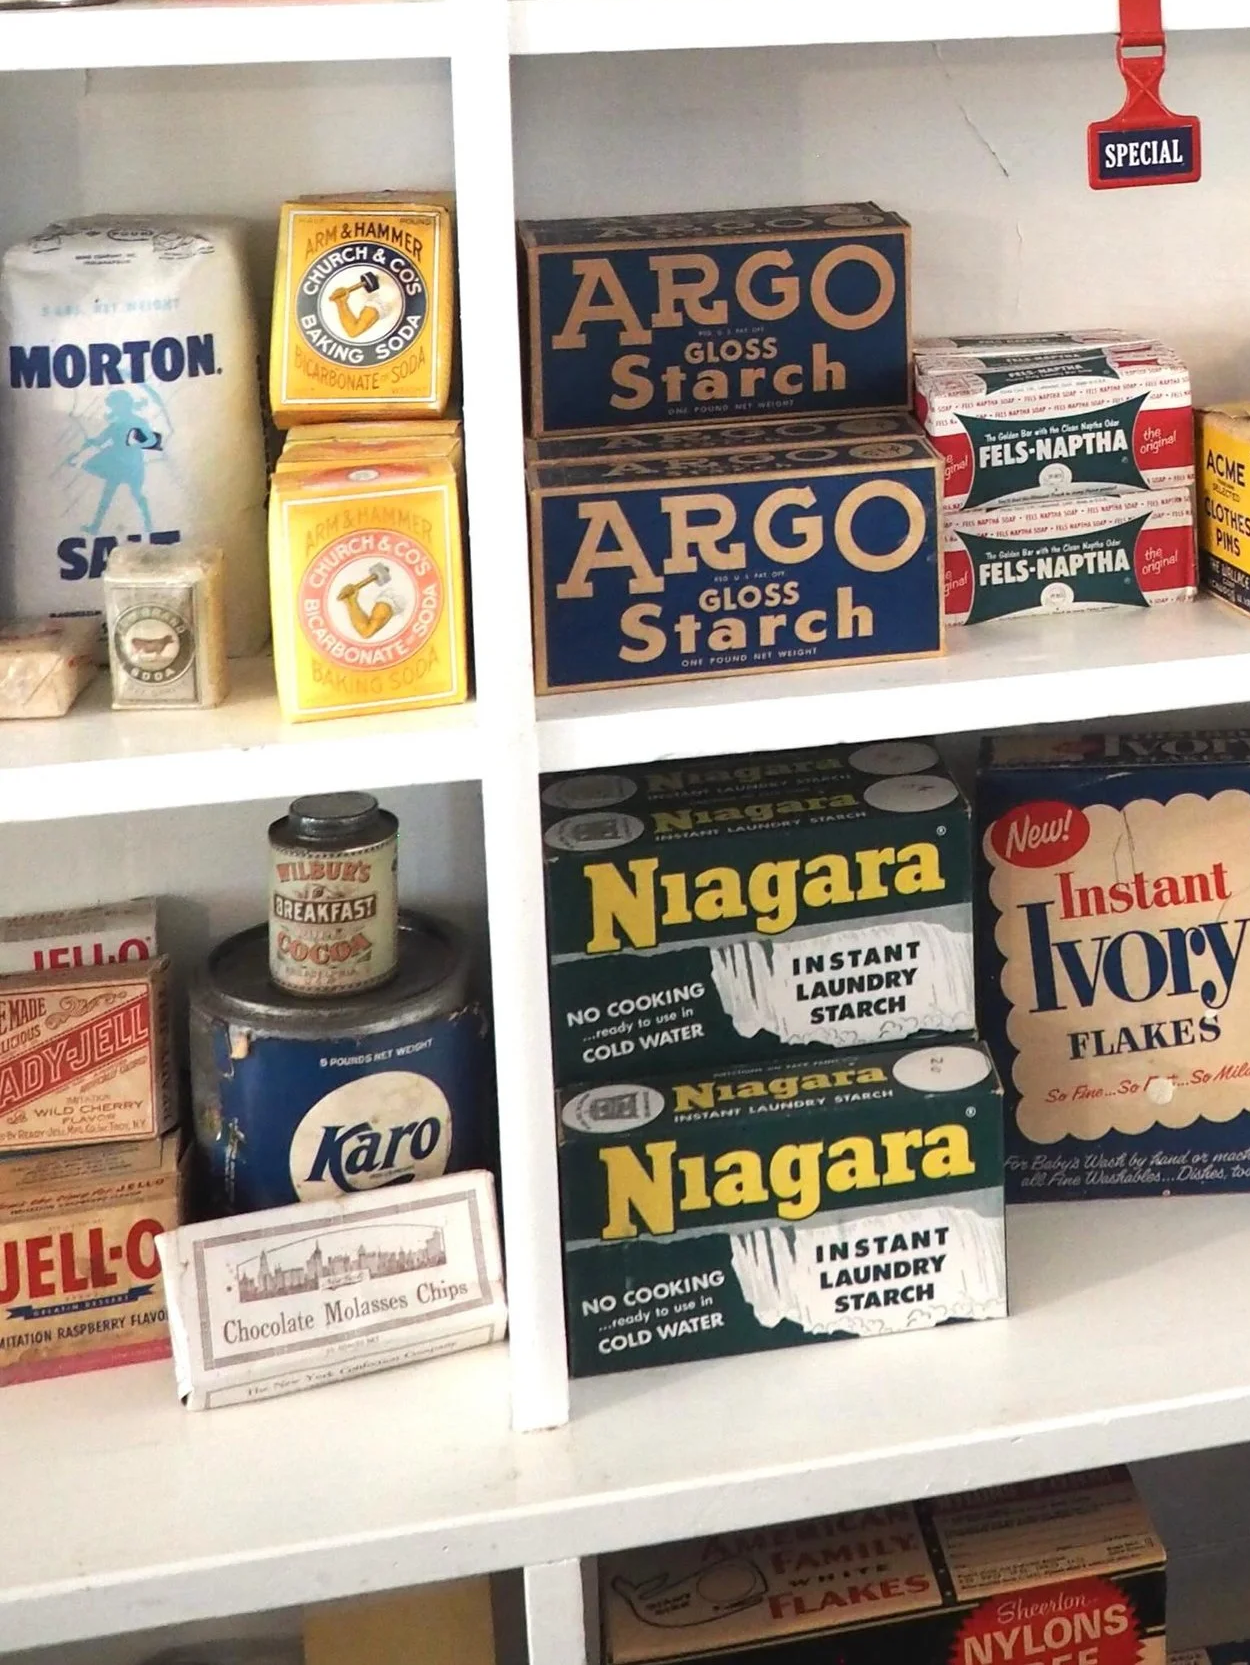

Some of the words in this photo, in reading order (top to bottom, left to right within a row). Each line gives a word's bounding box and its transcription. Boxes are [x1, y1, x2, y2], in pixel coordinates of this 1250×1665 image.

[1105, 139, 1183, 168] SPECIAL
[301, 315, 364, 363] BAKING
[375, 315, 421, 360] SODA
[979, 429, 1128, 469] FELS-NAPTHA
[556, 479, 926, 599] ARGO
[699, 582, 799, 612] GLOSS
[618, 587, 874, 663] Starch
[1005, 810, 1072, 860] New!
[277, 861, 371, 883] WILBUR'S
[1054, 863, 1232, 920] Instant
[275, 895, 376, 923] BREAKFAST
[584, 841, 945, 955] Niagara
[277, 931, 373, 965] COCOA
[792, 941, 921, 976] INSTANT
[796, 968, 919, 1001] LAUNDRY
[810, 996, 906, 1025] STARCH
[1068, 1015, 1221, 1061] FLAKES
[304, 1116, 441, 1193] Karo
[223, 1306, 315, 1345] Chocolate
[325, 1293, 407, 1325] Molasses
[417, 1281, 468, 1305] Chips
[964, 1604, 1128, 1665] NYLONS
